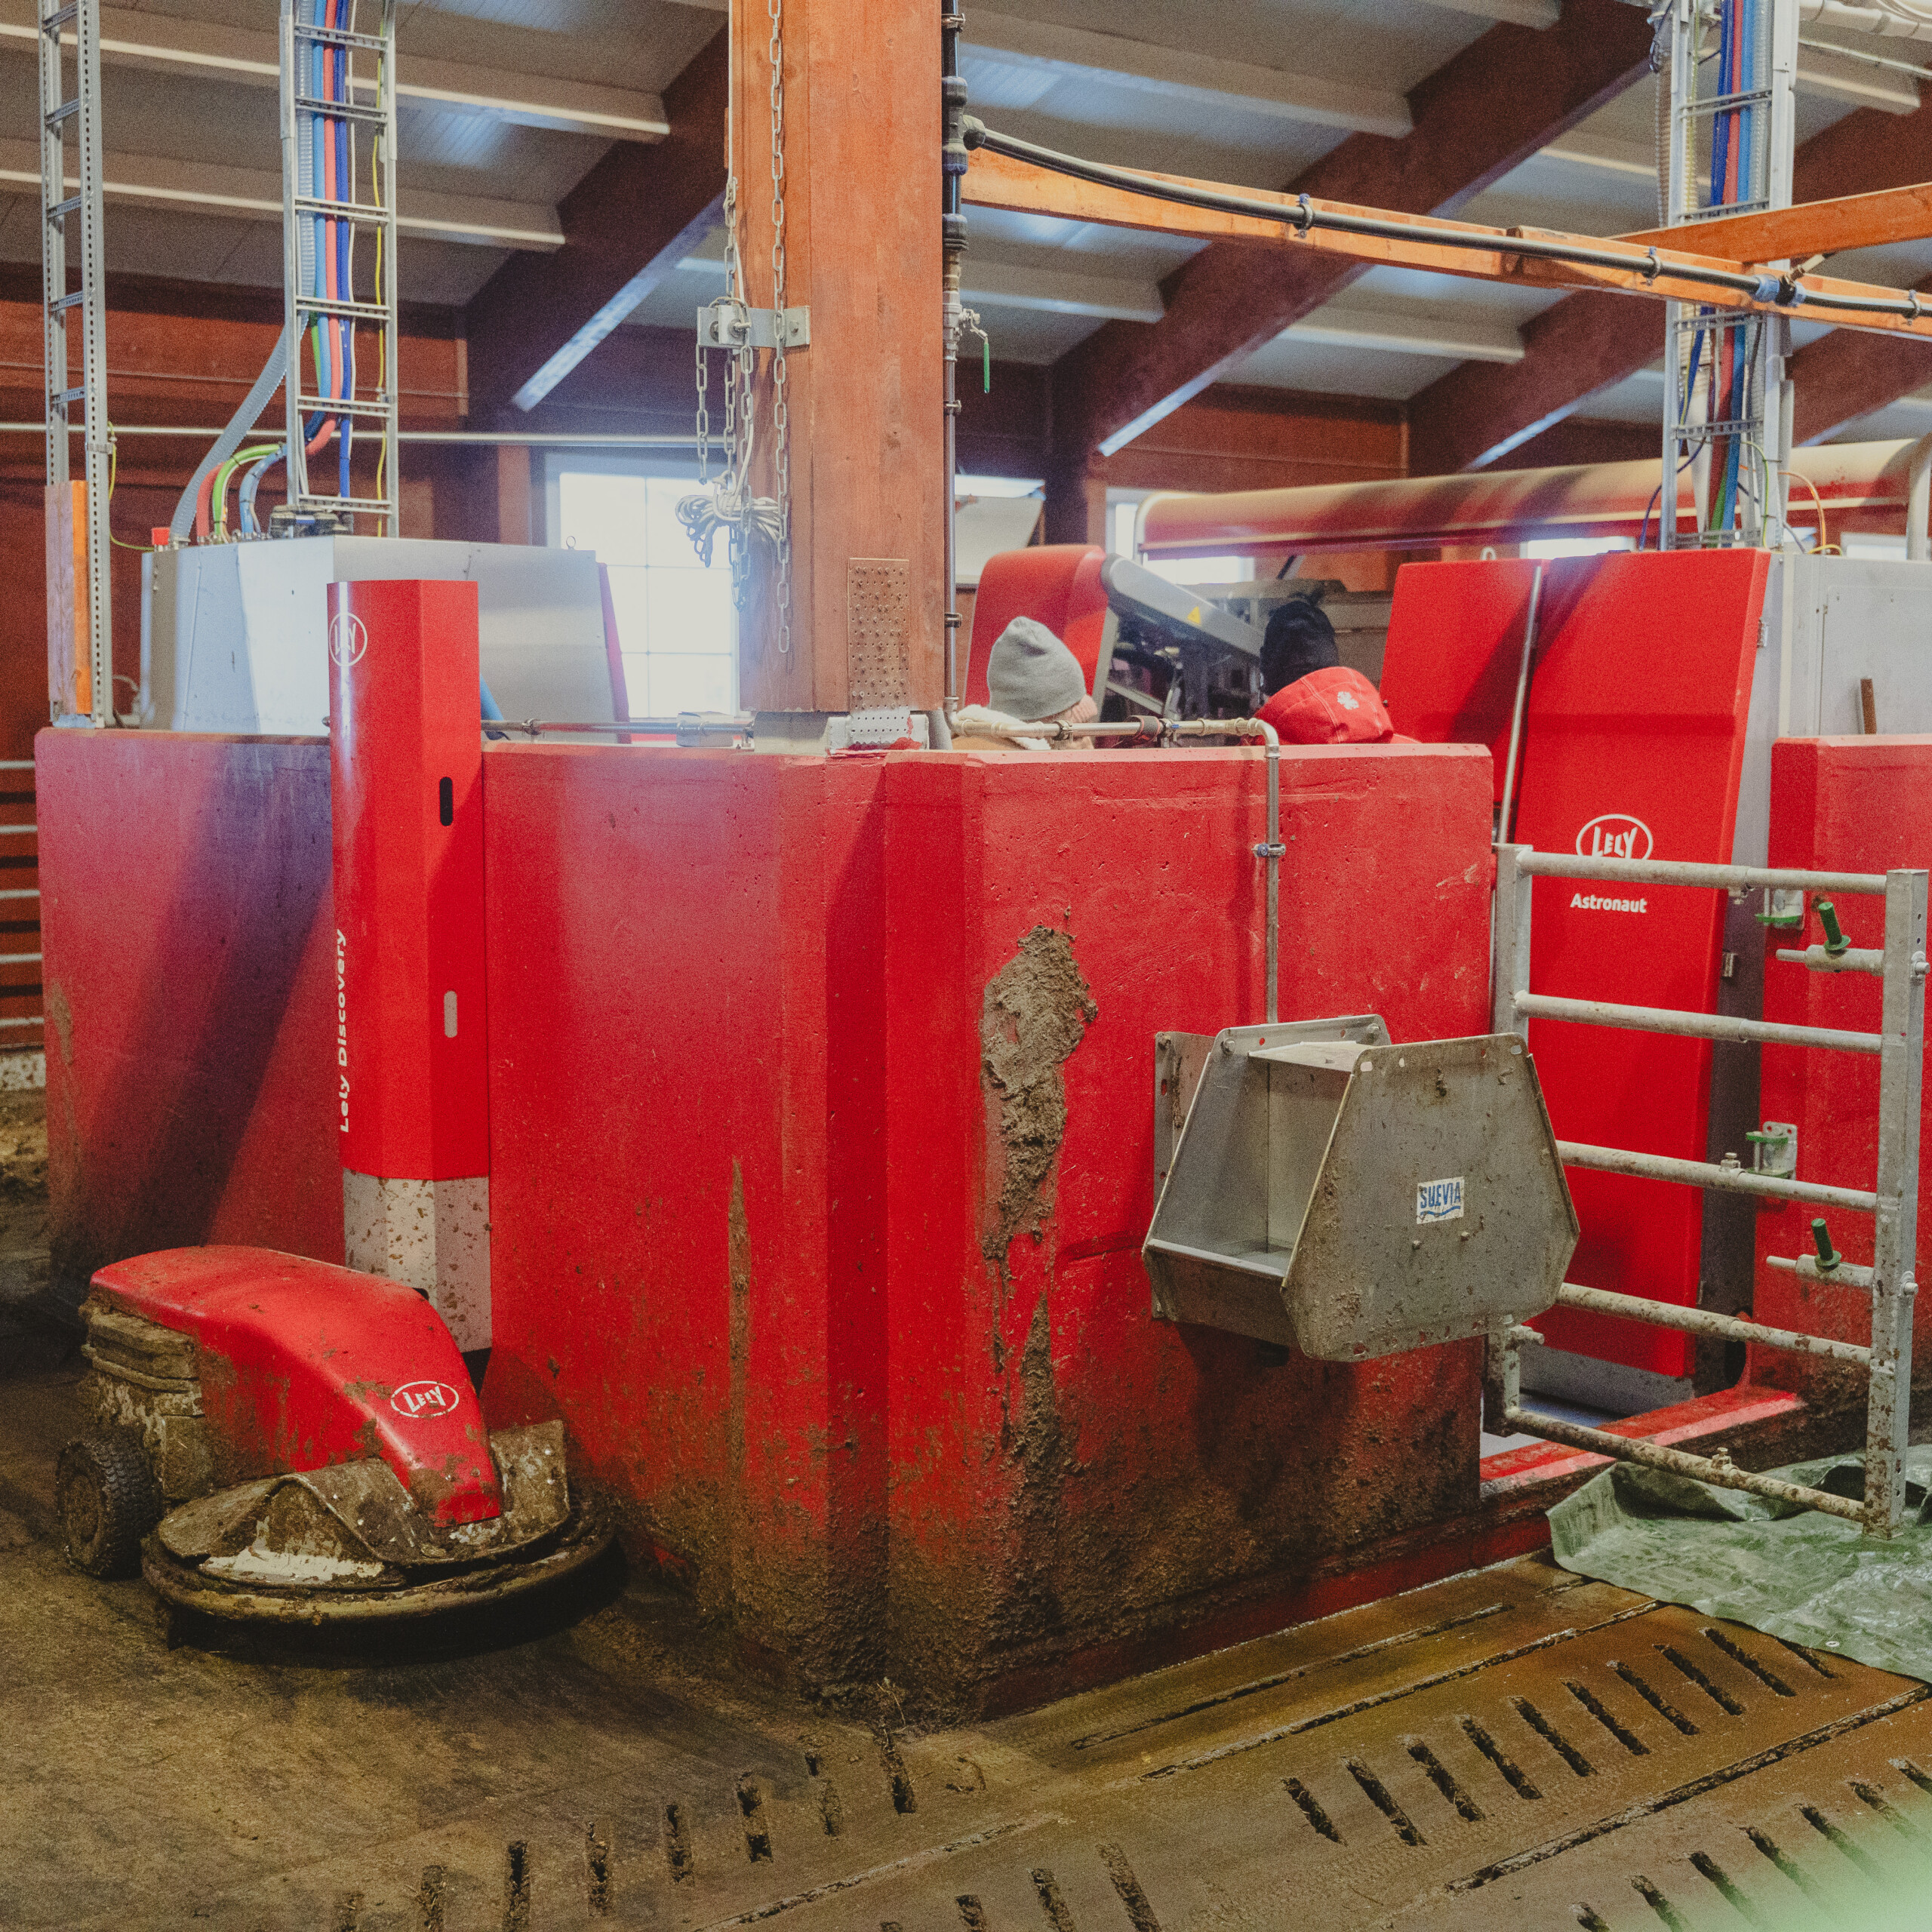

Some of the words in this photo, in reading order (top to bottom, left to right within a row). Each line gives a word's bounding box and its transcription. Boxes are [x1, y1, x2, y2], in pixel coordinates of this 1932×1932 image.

[334, 623, 356, 655] LLY
[1592, 826, 1638, 860] LELY
[1570, 893, 1647, 914] Astronaut
[337, 928, 347, 1068] Discovery
[340, 1074, 350, 1134] Lely
[1419, 1182, 1461, 1209] SUEVIA
[402, 1386, 446, 1413] LELY
